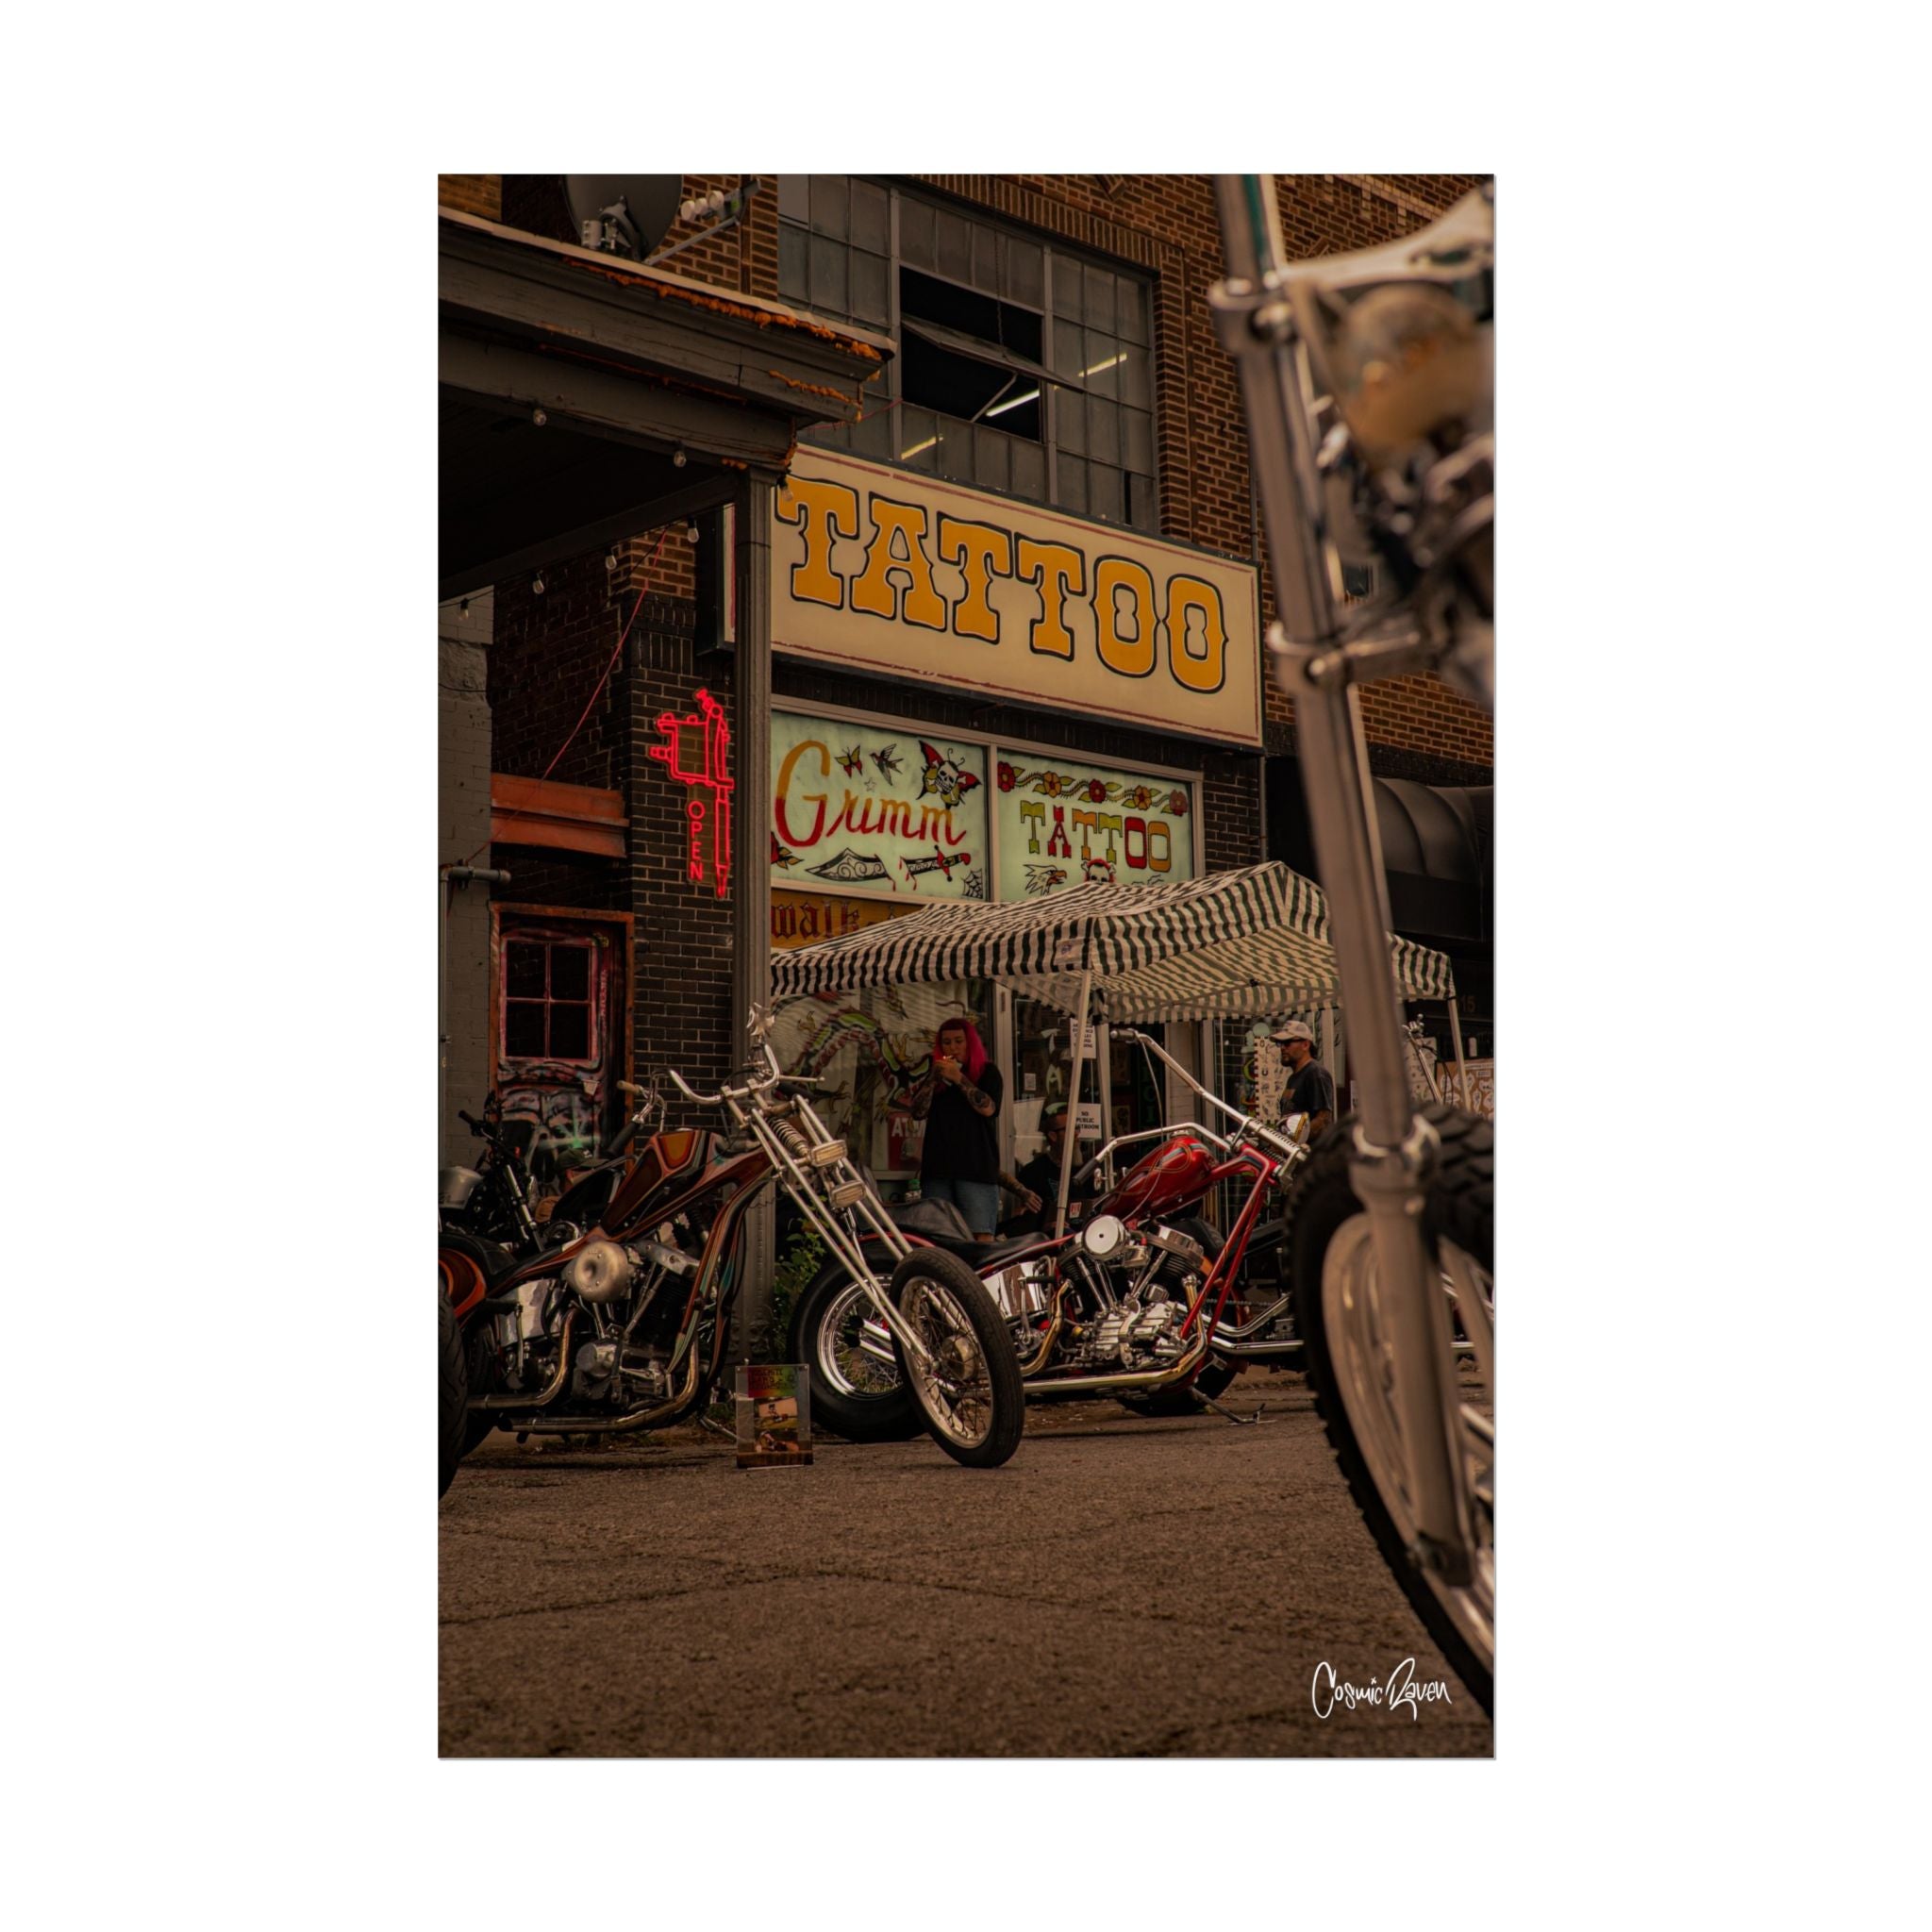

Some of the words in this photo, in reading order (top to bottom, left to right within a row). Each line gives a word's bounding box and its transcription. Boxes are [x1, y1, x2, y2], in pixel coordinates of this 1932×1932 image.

[774, 473, 1229, 694] TATTOO
[774, 740, 967, 847] Grimm
[1020, 800, 1172, 873] TATTOO
[686, 801, 706, 881] OPEN
